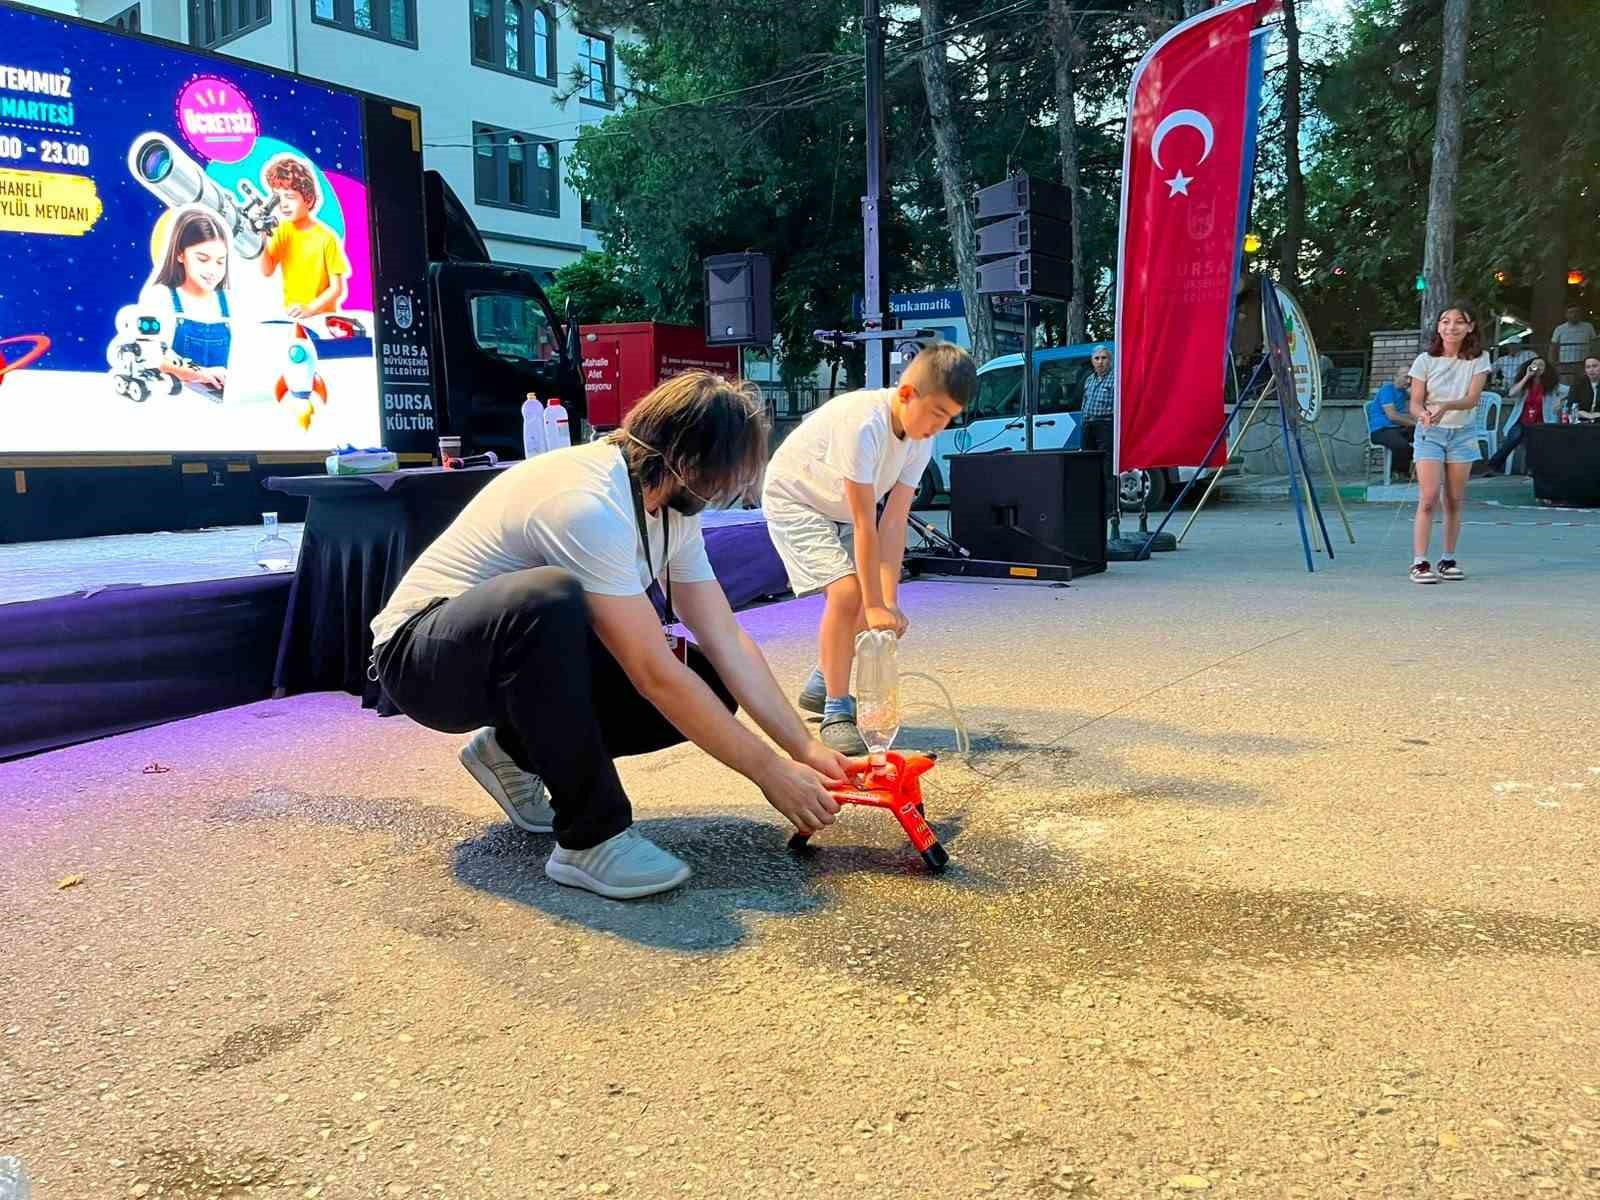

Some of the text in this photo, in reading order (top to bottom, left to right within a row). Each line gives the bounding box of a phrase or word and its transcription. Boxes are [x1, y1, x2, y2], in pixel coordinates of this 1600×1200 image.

[0, 65, 72, 98] TEMMUZ
[41, 140, 89, 166] 23.00
[0, 180, 42, 198] HANELİ
[35, 204, 89, 221] MEYDANI
[888, 298, 951, 313] Bankamatik
[383, 343, 428, 357] BURSA
[384, 394, 433, 410] BURSA
[386, 413, 434, 430] KÜLTÜR
